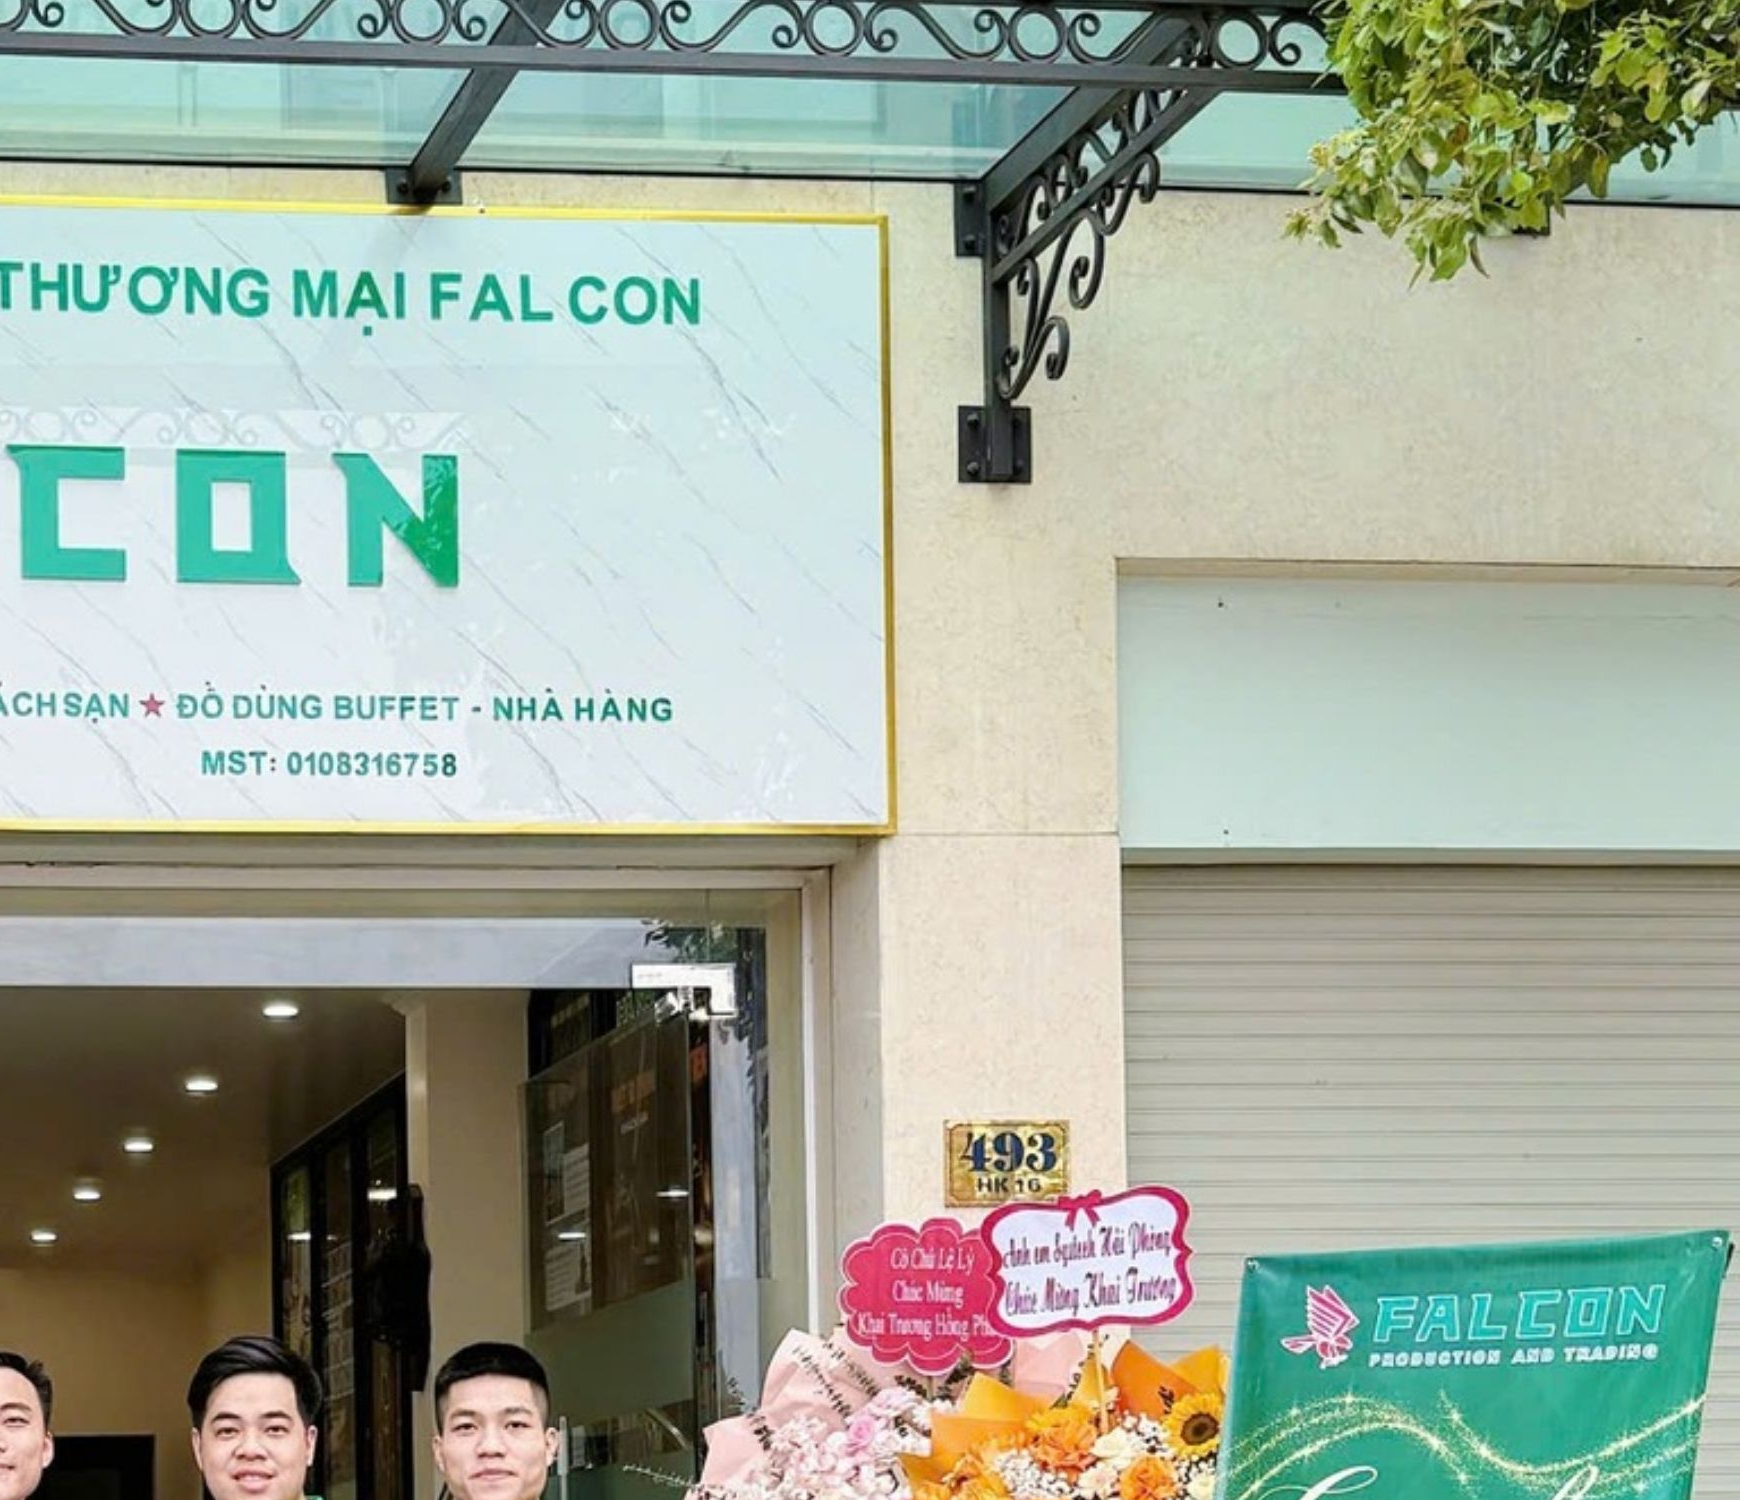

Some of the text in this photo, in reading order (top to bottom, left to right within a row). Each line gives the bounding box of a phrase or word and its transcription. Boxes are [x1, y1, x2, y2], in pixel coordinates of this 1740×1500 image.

[292, 269, 406, 337] MẠI
[63, 693, 131, 725] SẠN
[232, 684, 324, 721] DÙNG
[333, 695, 461, 722] BUFFET
[492, 688, 562, 722] NHÀ
[574, 690, 675, 723] HÀNG
[201, 750, 458, 777] MST: 0108316758
[961, 1132, 1057, 1172] 493
[977, 1178, 1009, 1195] HK
[1372, 1286, 1666, 1342] FALCON
[1368, 1343, 1660, 1368] PRODUCTION AND TRADING
